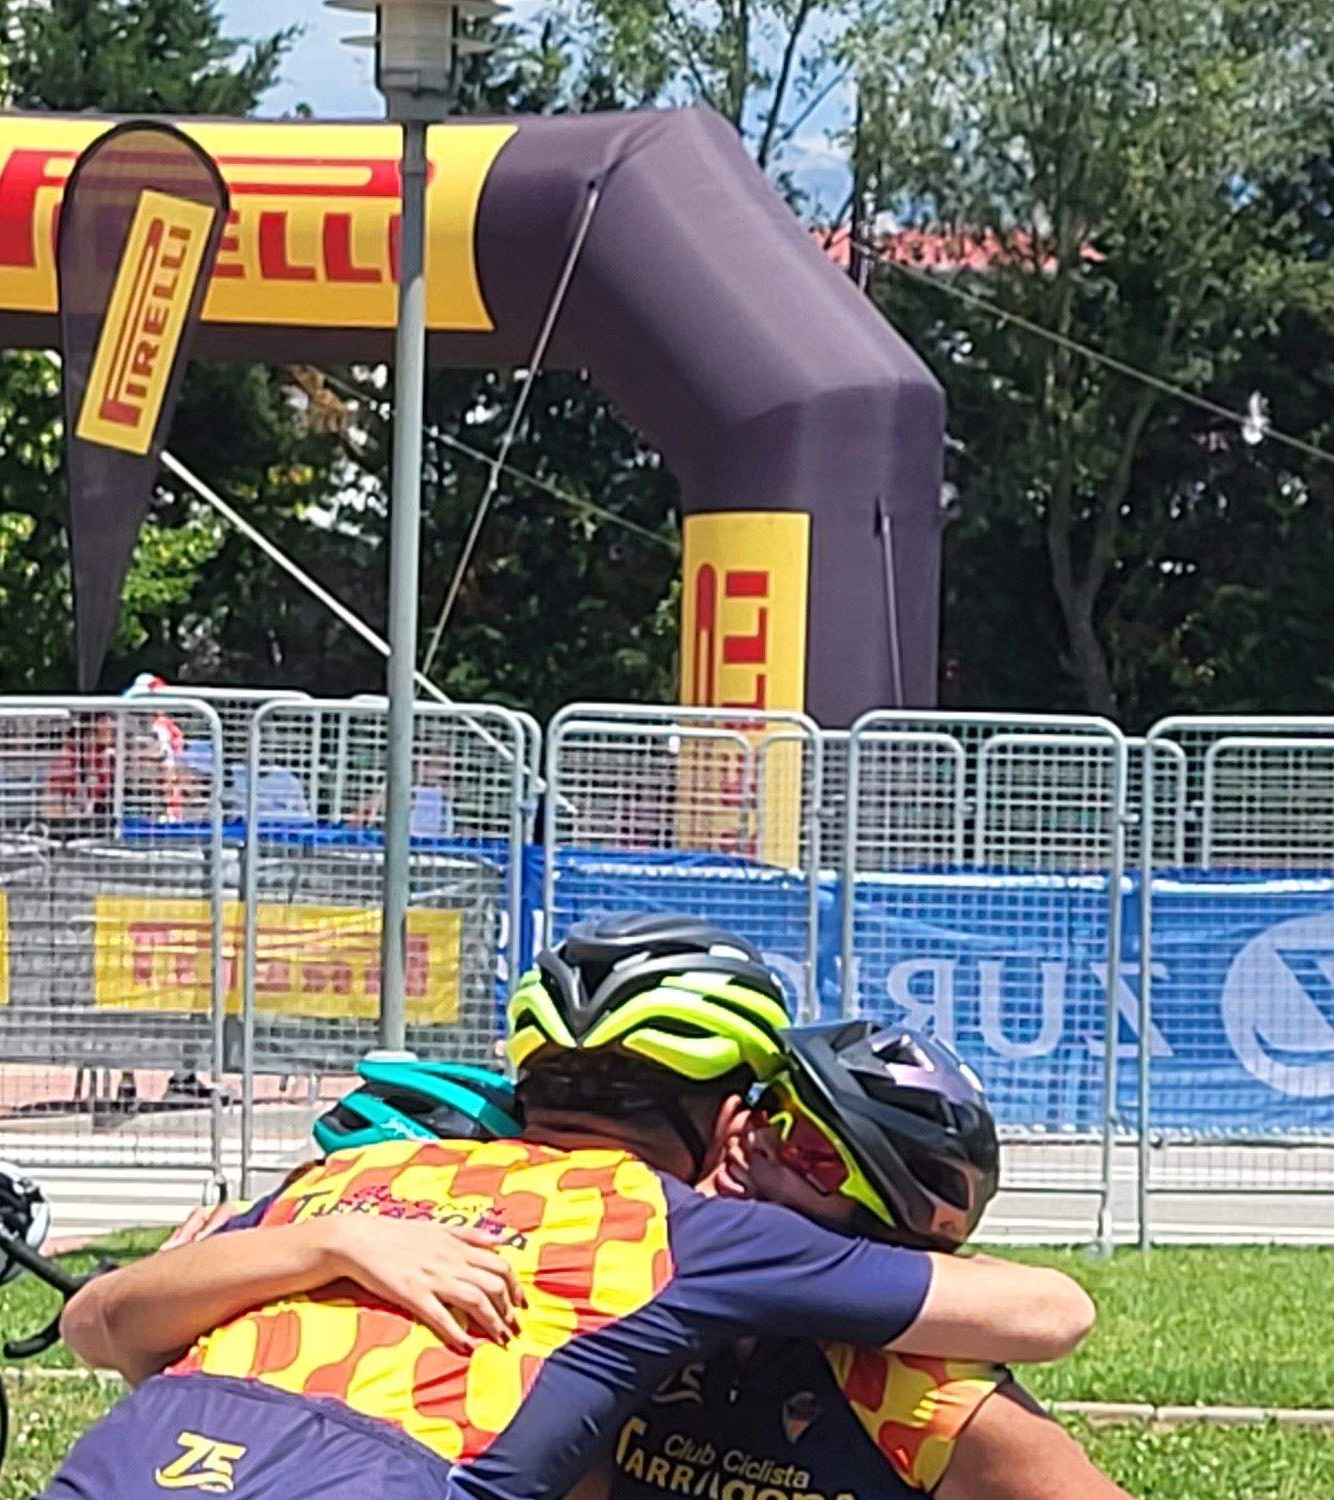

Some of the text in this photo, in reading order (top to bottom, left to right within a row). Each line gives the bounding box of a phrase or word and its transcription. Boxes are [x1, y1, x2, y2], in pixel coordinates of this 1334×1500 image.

[99, 217, 192, 429] PIRELLI
[155, 1430, 248, 1491] 75
[665, 1433, 811, 1490] Club Ciclista
